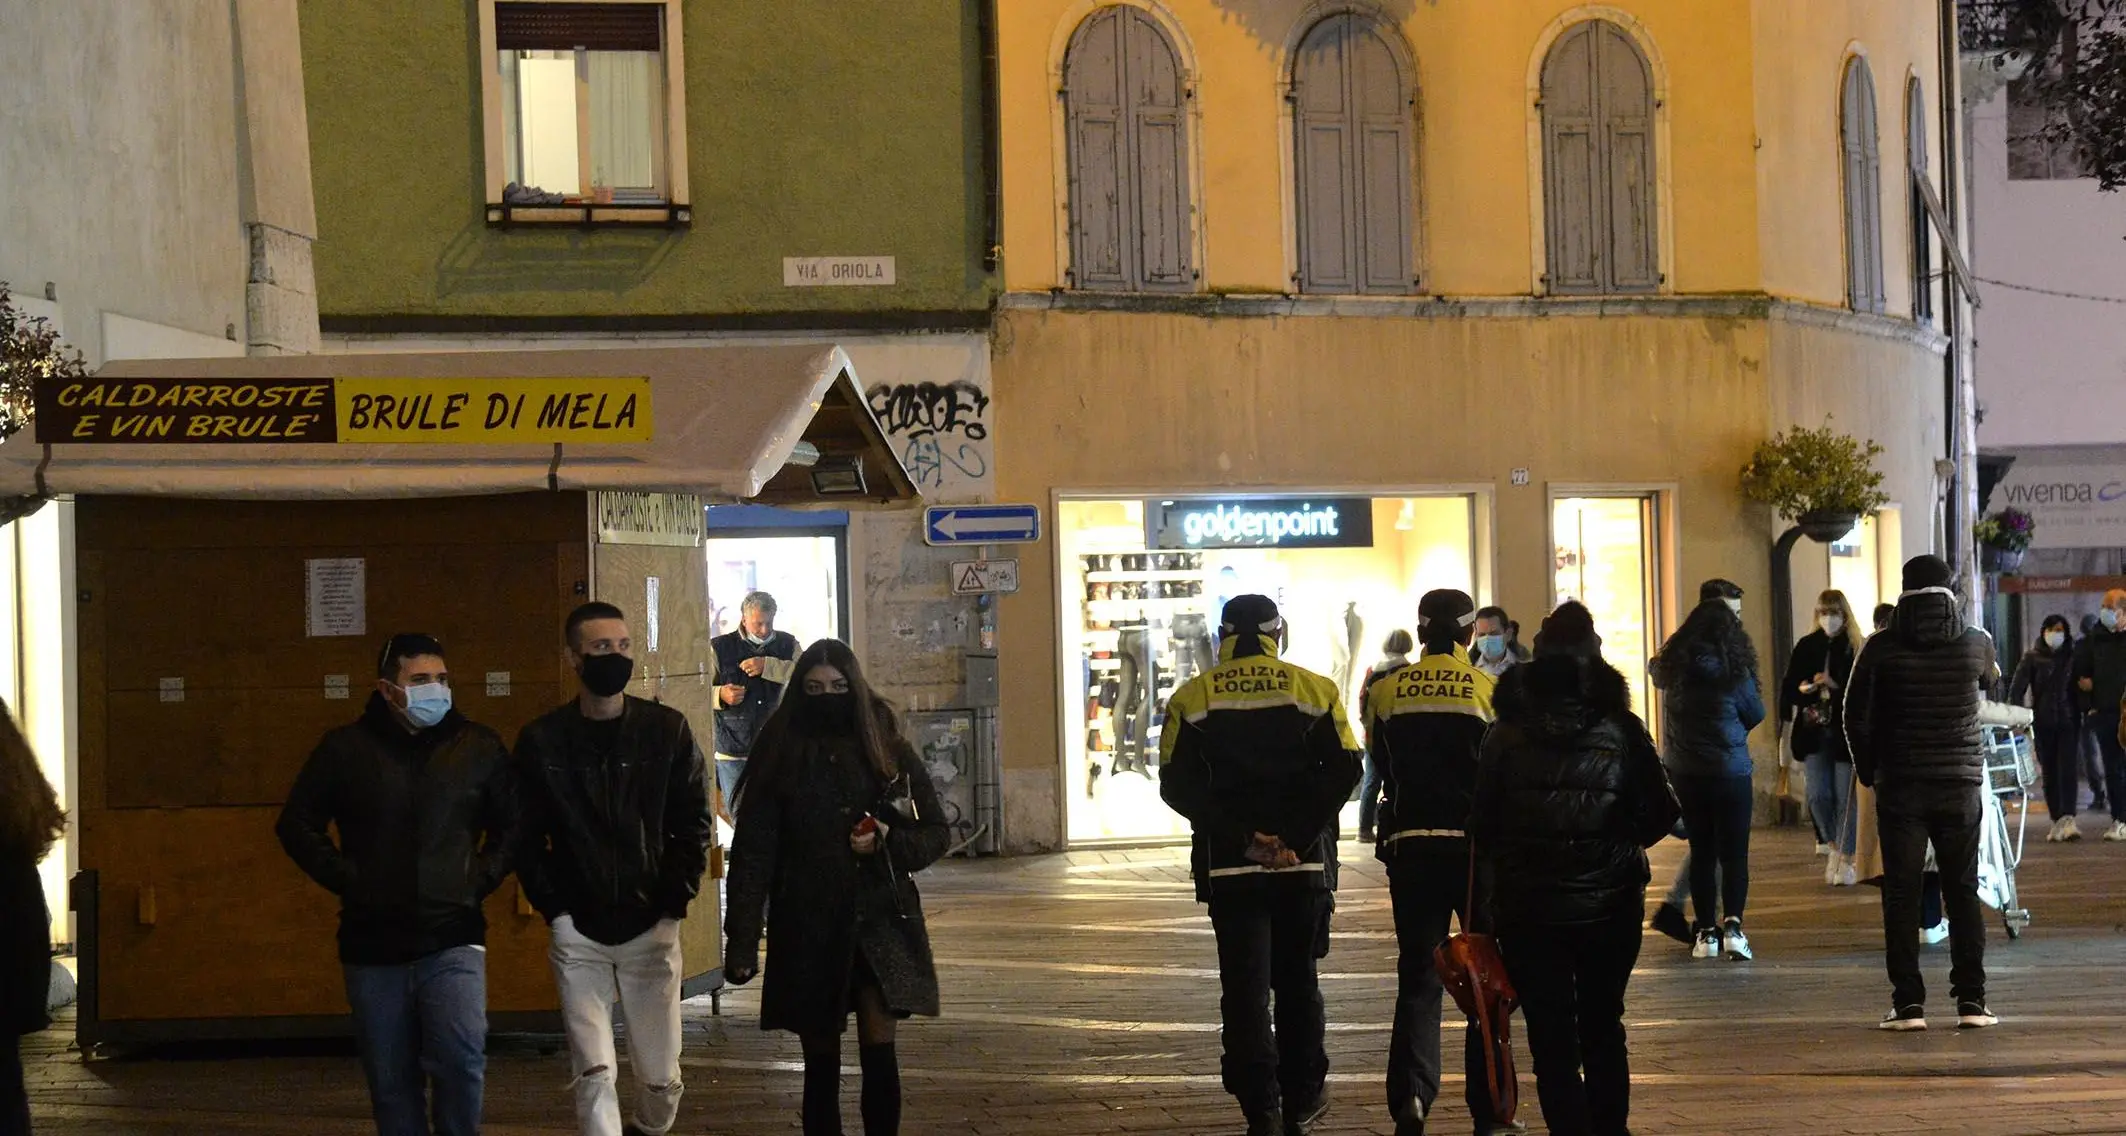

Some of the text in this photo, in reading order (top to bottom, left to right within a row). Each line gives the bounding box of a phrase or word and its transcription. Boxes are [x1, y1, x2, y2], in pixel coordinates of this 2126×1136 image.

[796, 263, 883, 279] VIA ORIOLA
[57, 384, 330, 408] CALDARROSTE
[349, 392, 638, 430] BRULE' DI MELA
[72, 414, 320, 438] E VIN BRULE'
[1183, 502, 1339, 544] goldenpoint
[1212, 665, 1289, 682] POLIZIA
[1397, 669, 1475, 685] POLIZIA
[1213, 679, 1290, 694] LOCALE
[1395, 683, 1475, 700] LOCALE
